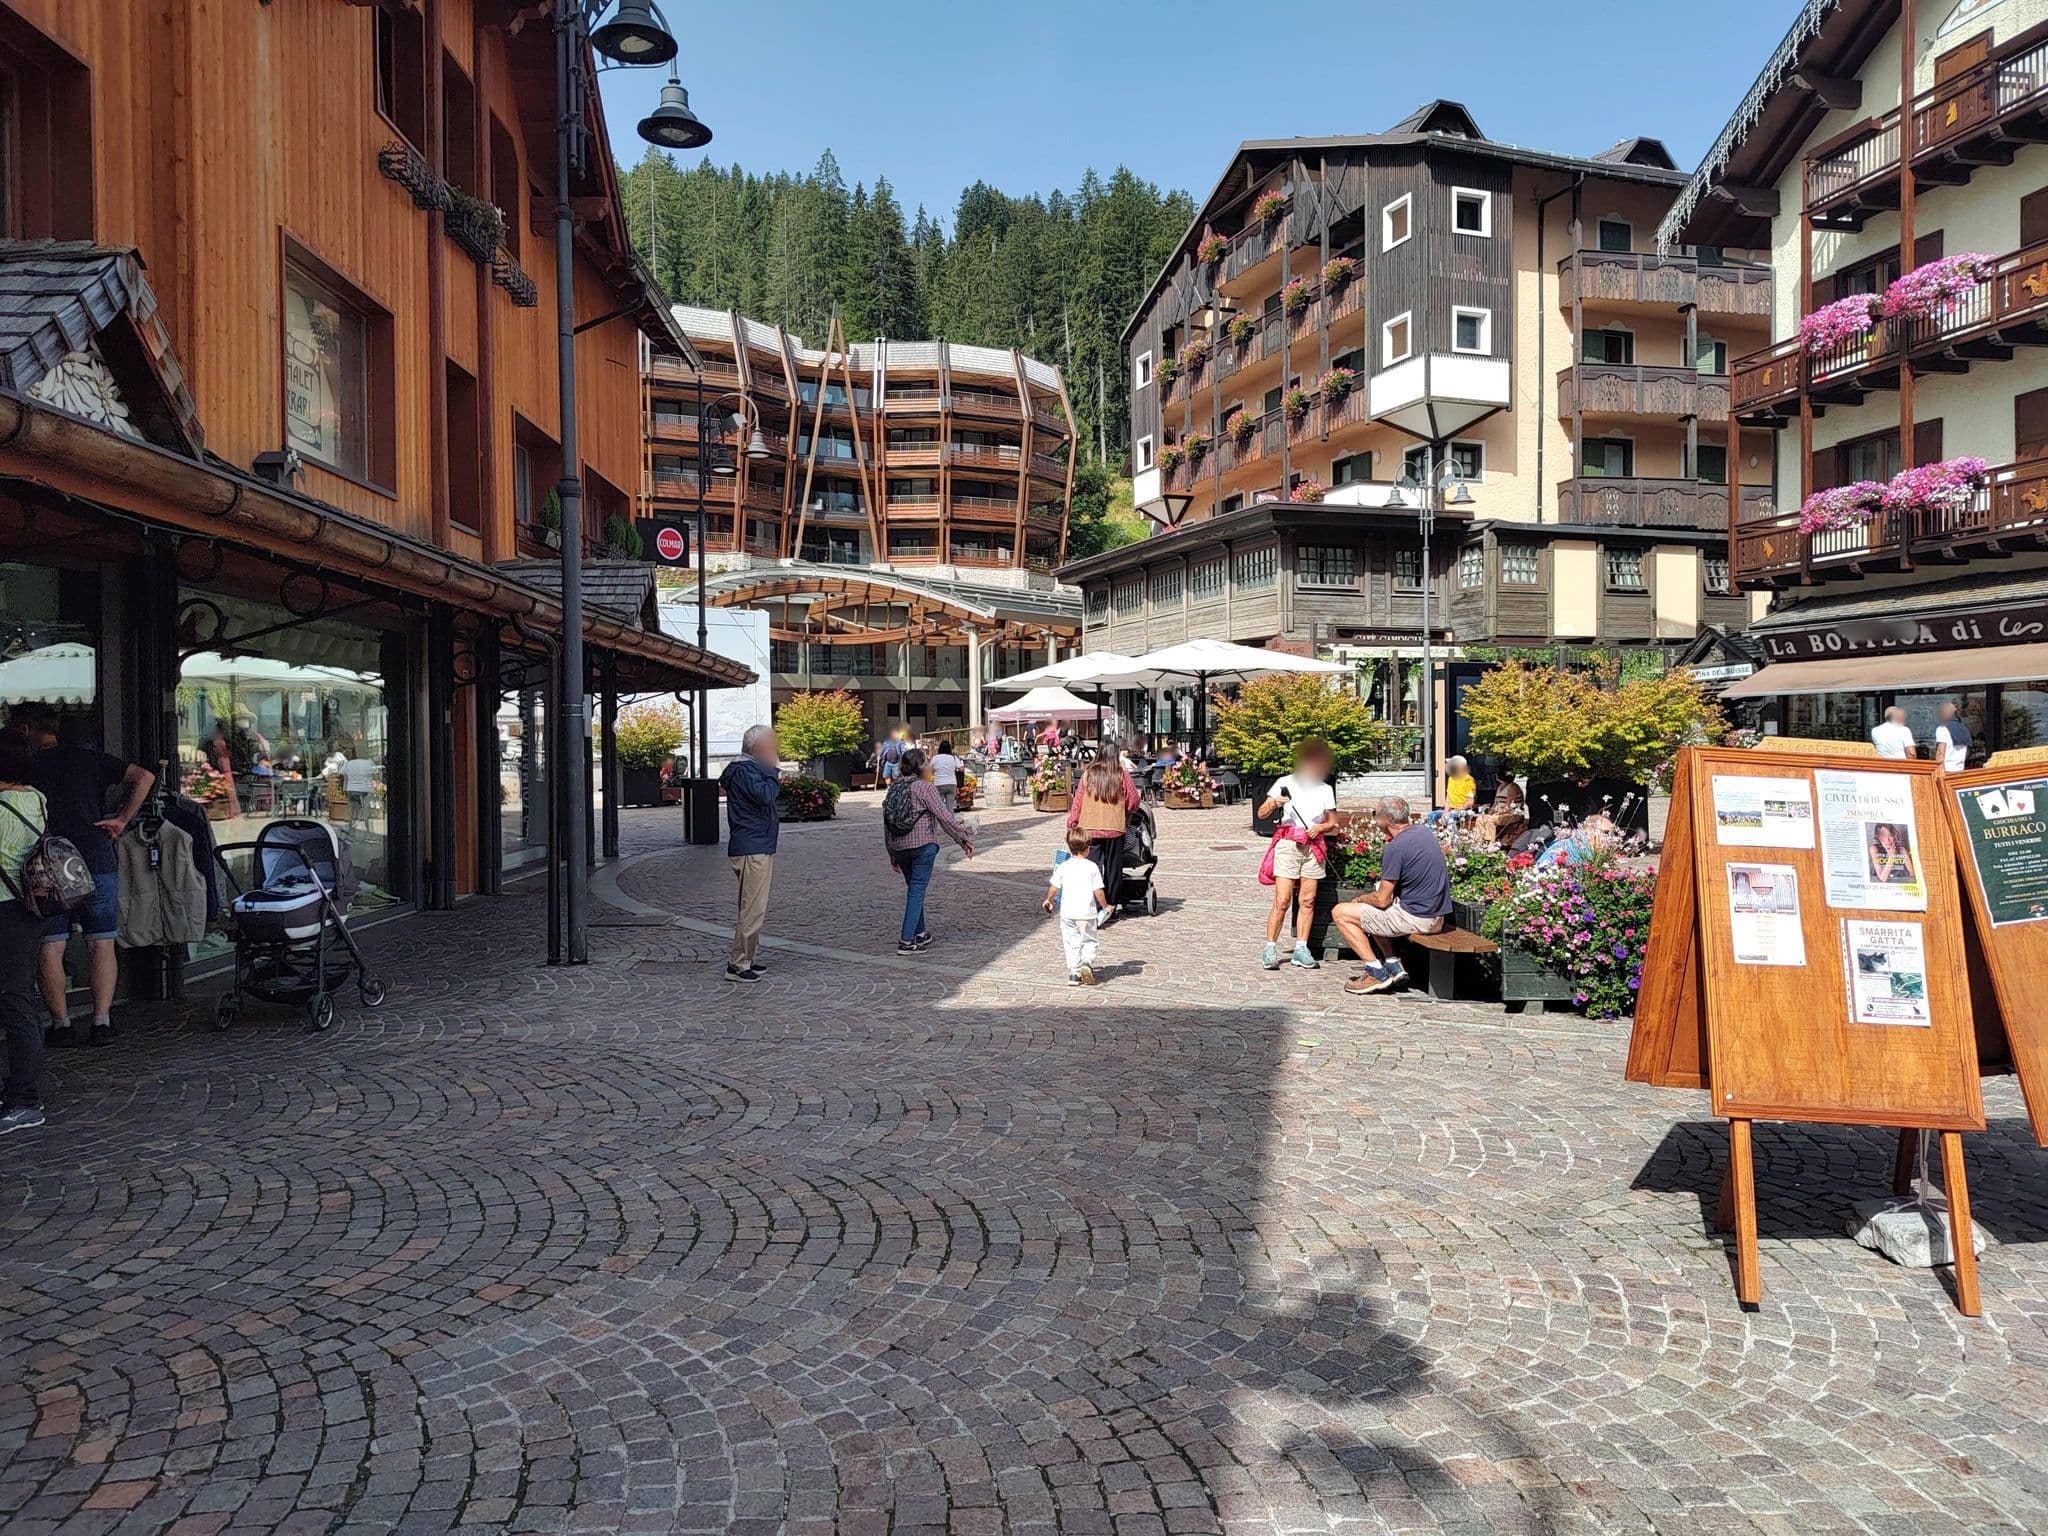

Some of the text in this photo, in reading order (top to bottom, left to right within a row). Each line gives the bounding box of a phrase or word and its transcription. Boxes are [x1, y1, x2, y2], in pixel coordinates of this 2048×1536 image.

[659, 538, 682, 549] COLMAR
[1769, 639, 1797, 655] La
[1951, 619, 1983, 640] di
[1983, 821, 2047, 840] BURRACO
[1859, 927, 1912, 938] SMARRITA
[1870, 936, 1905, 946] GATTA
